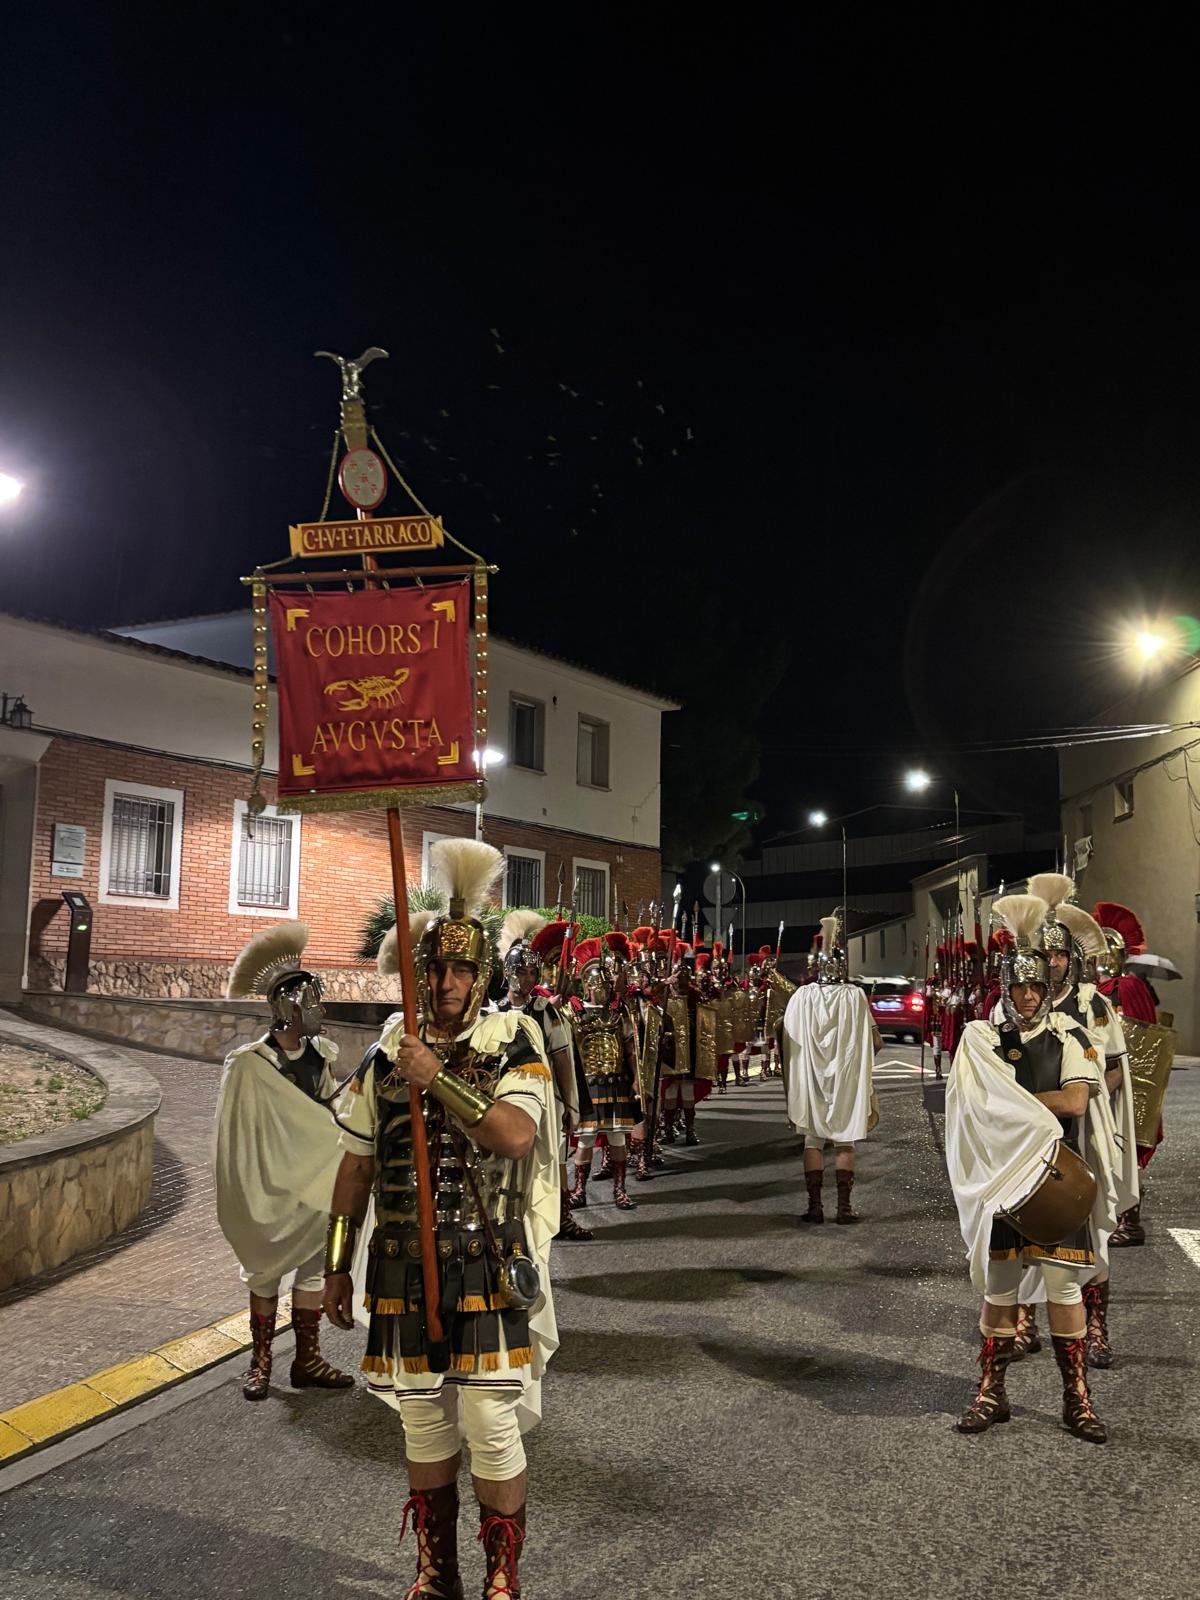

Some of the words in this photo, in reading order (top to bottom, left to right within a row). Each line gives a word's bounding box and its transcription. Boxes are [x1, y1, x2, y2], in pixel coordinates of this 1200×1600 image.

[306, 623, 421, 657] COHORS
[433, 619, 439, 649] I
[311, 717, 445, 755] AVGVSTA
